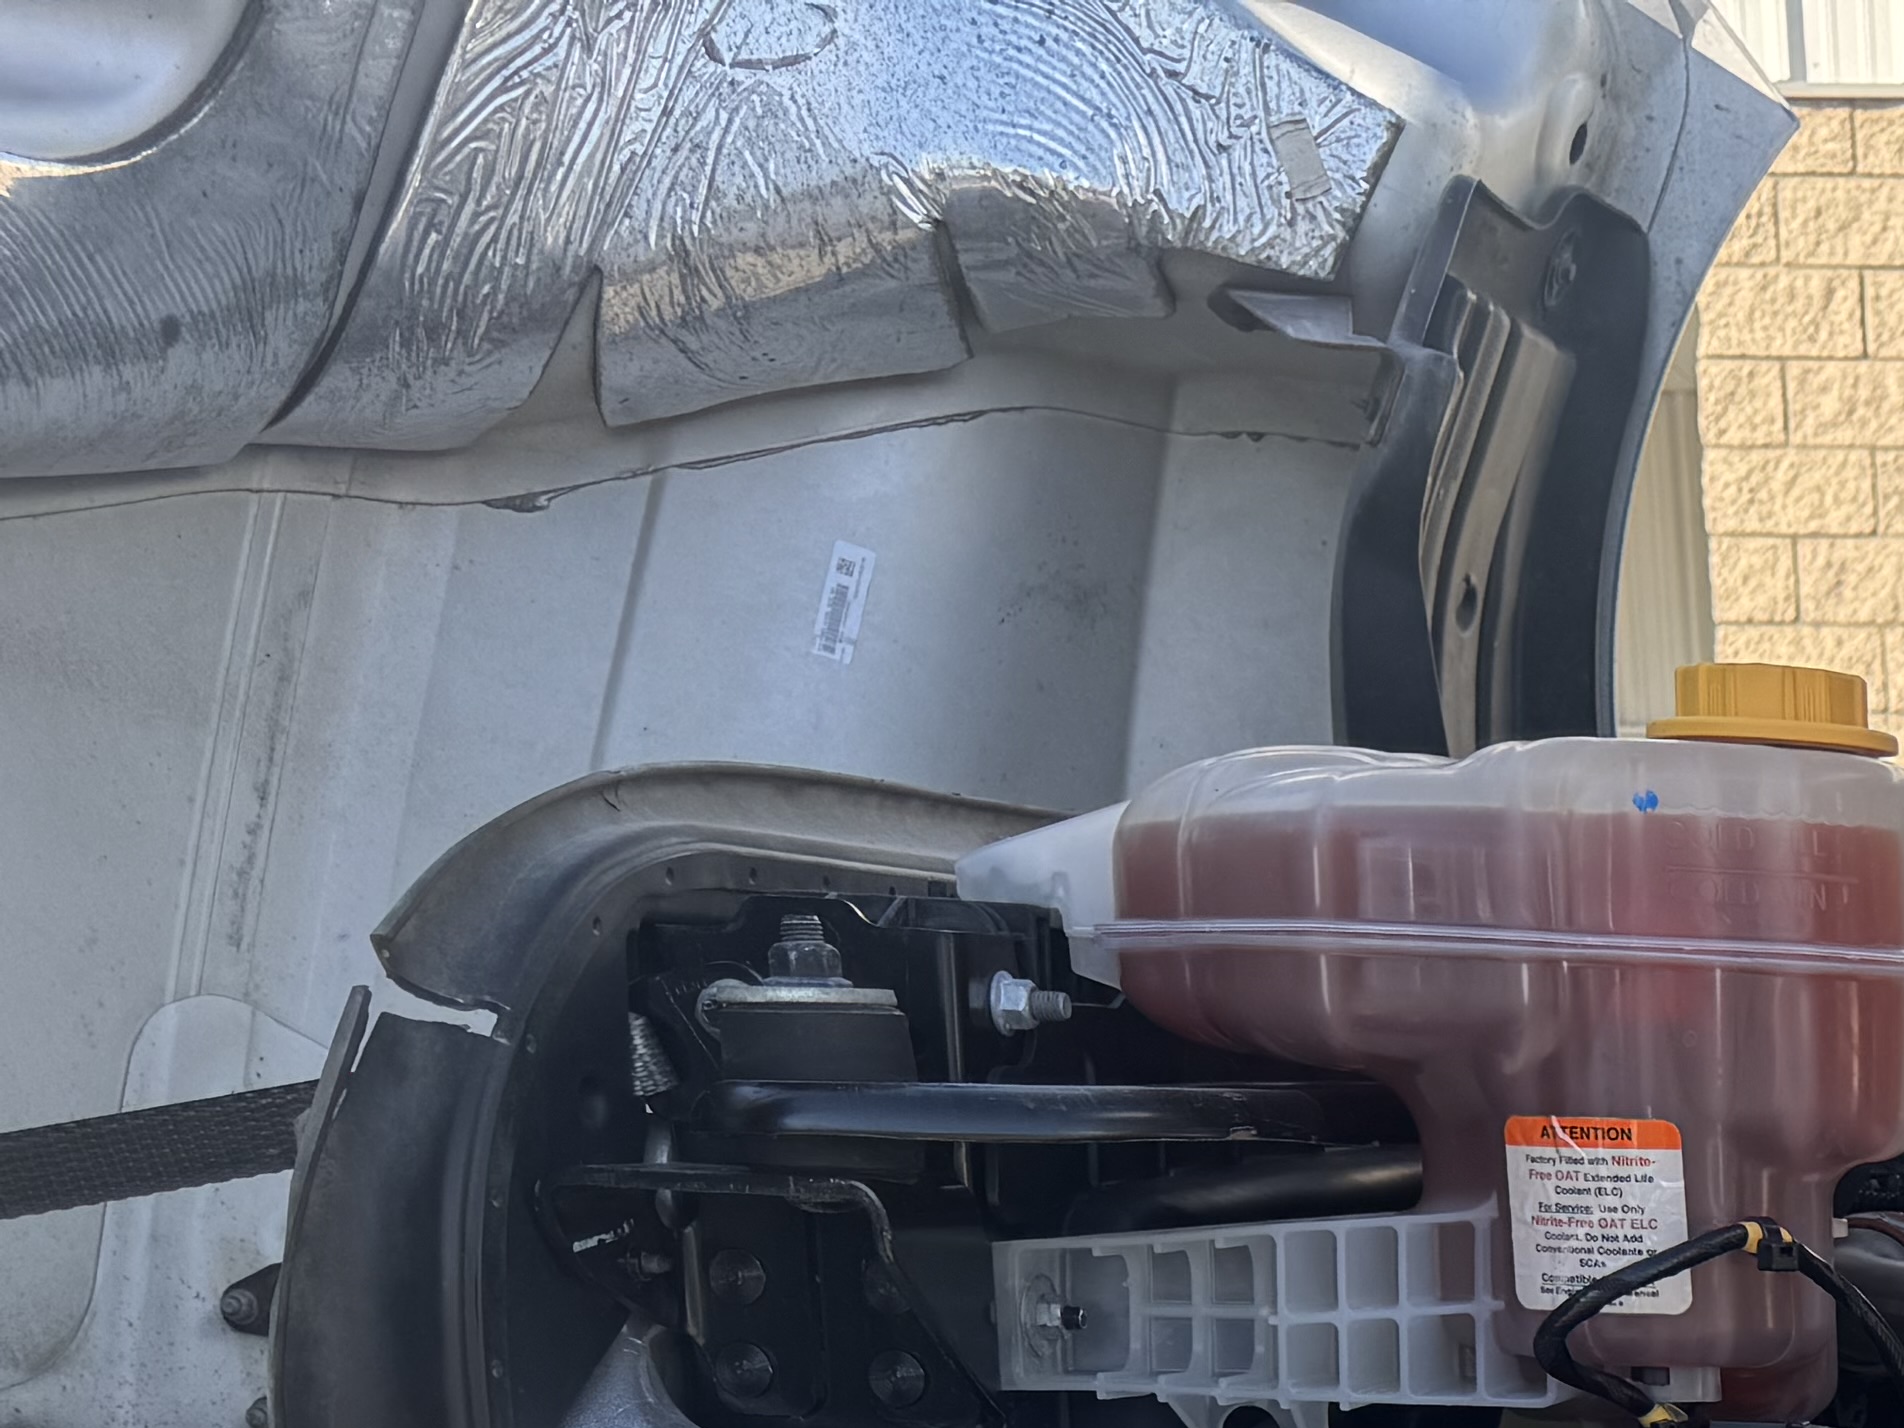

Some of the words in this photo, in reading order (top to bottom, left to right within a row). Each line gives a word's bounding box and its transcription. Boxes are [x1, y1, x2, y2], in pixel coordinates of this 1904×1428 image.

[1612, 1156, 1655, 1167] Nitrite-
[1529, 1169, 1552, 1181] Free
[1555, 1170, 1580, 1181] OAT
[1584, 1172, 1631, 1183] Extended
[1634, 1174, 1654, 1183] Life
[1555, 1186, 1592, 1196] Coolant
[1595, 1187, 1623, 1198] (ELC)
[1598, 1204, 1618, 1214] Use
[1622, 1205, 1645, 1216] Only
[1598, 1218, 1626, 1229] OAT
[1631, 1219, 1658, 1230] ELC
[1585, 1233, 1598, 1242] Do
[1601, 1234, 1619, 1242] Not
[1623, 1234, 1643, 1243] Add
